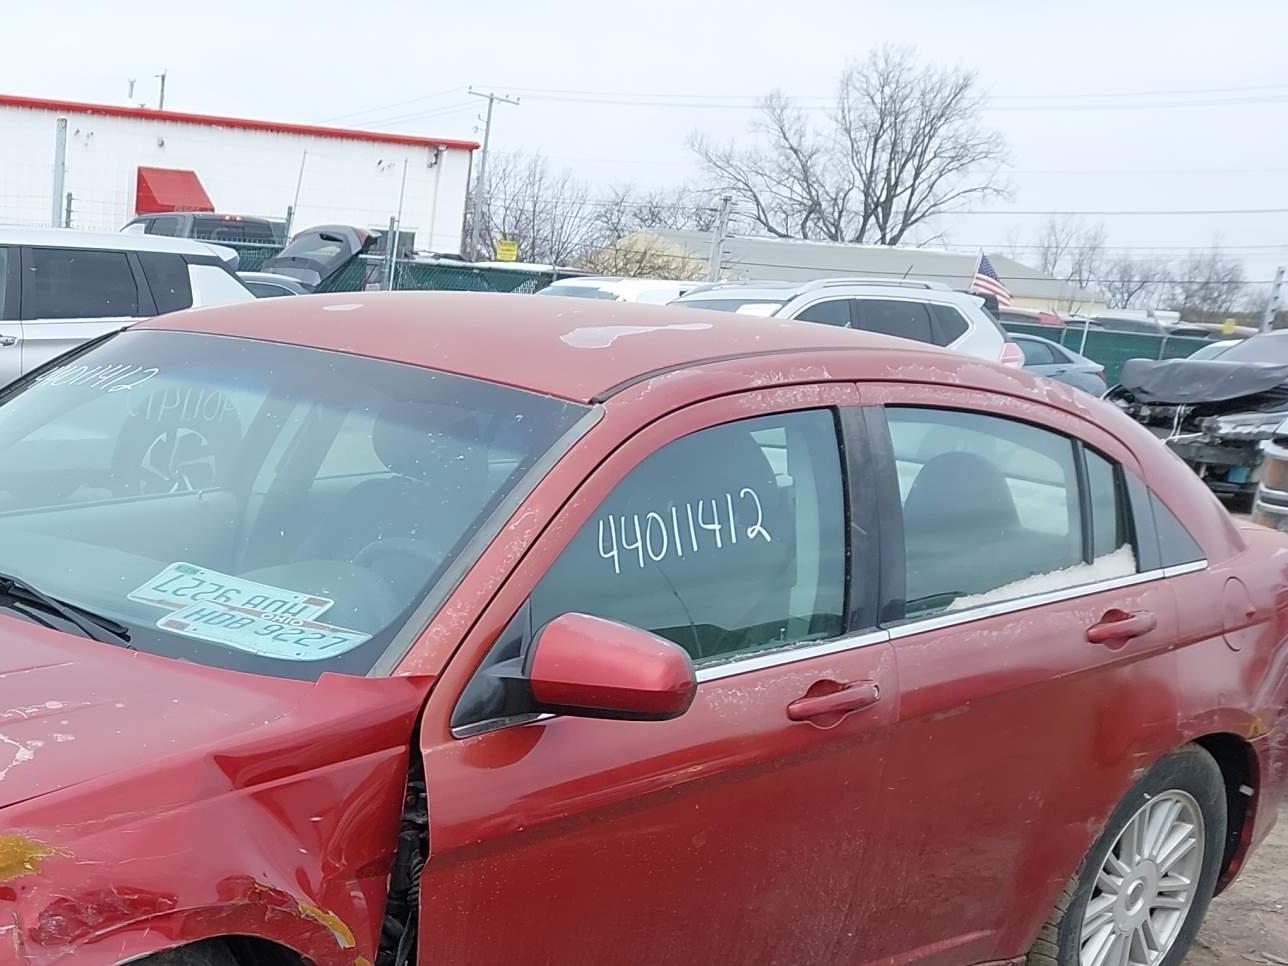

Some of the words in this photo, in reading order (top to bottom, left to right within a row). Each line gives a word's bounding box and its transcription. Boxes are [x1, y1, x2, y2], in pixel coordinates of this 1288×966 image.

[599, 487, 772, 574] 44011412
[183, 607, 255, 630] HDB
[254, 624, 349, 650] 9227
[261, 612, 304, 627] OHIO
